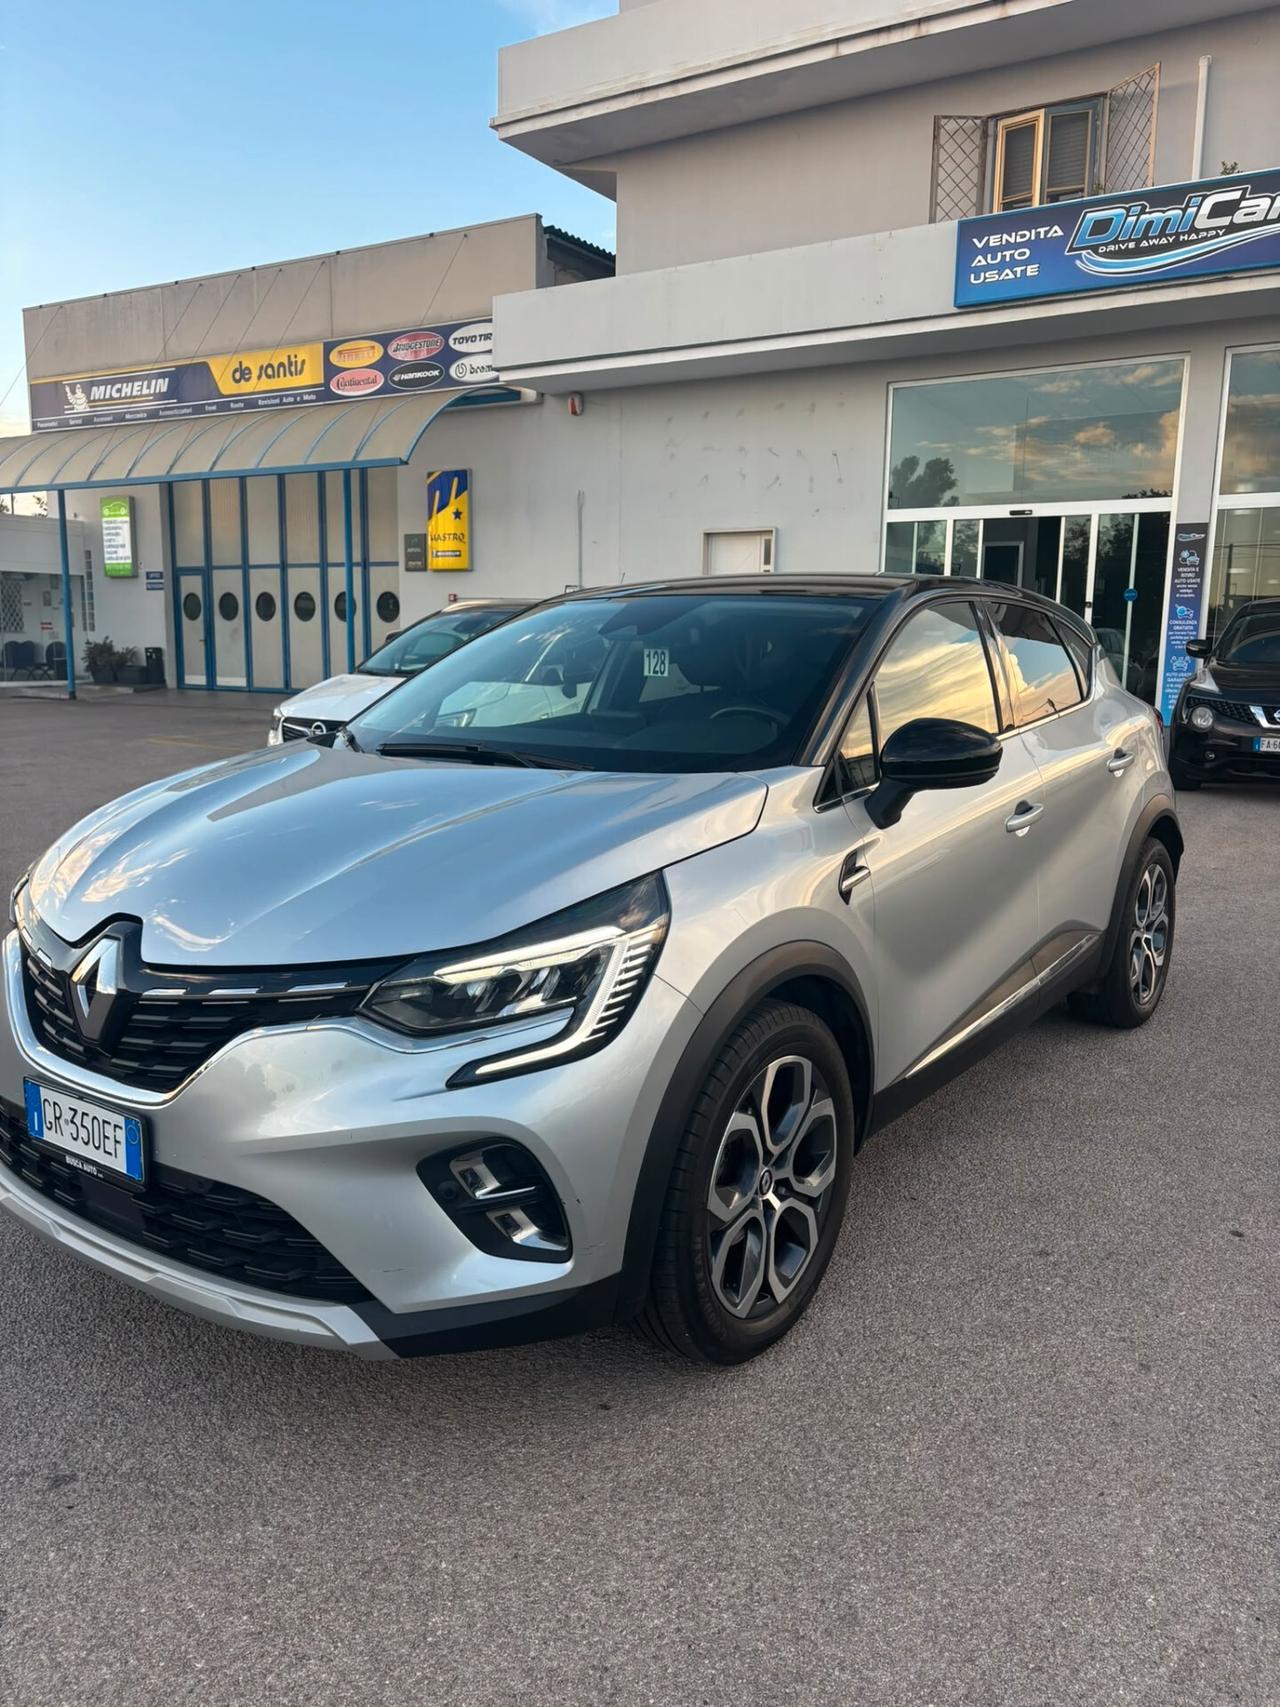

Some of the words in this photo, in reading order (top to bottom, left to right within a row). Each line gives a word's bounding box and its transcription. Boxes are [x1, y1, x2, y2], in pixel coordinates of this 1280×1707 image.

[971, 224, 1065, 249] VENDITA
[1098, 241, 1137, 253] DRIVE
[1139, 235, 1177, 248] AWAY
[1179, 228, 1227, 242] HAPPY
[970, 247, 1031, 268] AUTO
[969, 263, 1041, 285] USATE
[392, 338, 441, 353] BRIDGESTONE
[452, 334, 477, 346] TOYO
[231, 361, 253, 384] de
[256, 354, 306, 381] santis
[90, 377, 169, 401] MICHELIN
[336, 374, 378, 391] Continental
[645, 650, 666, 675] 128
